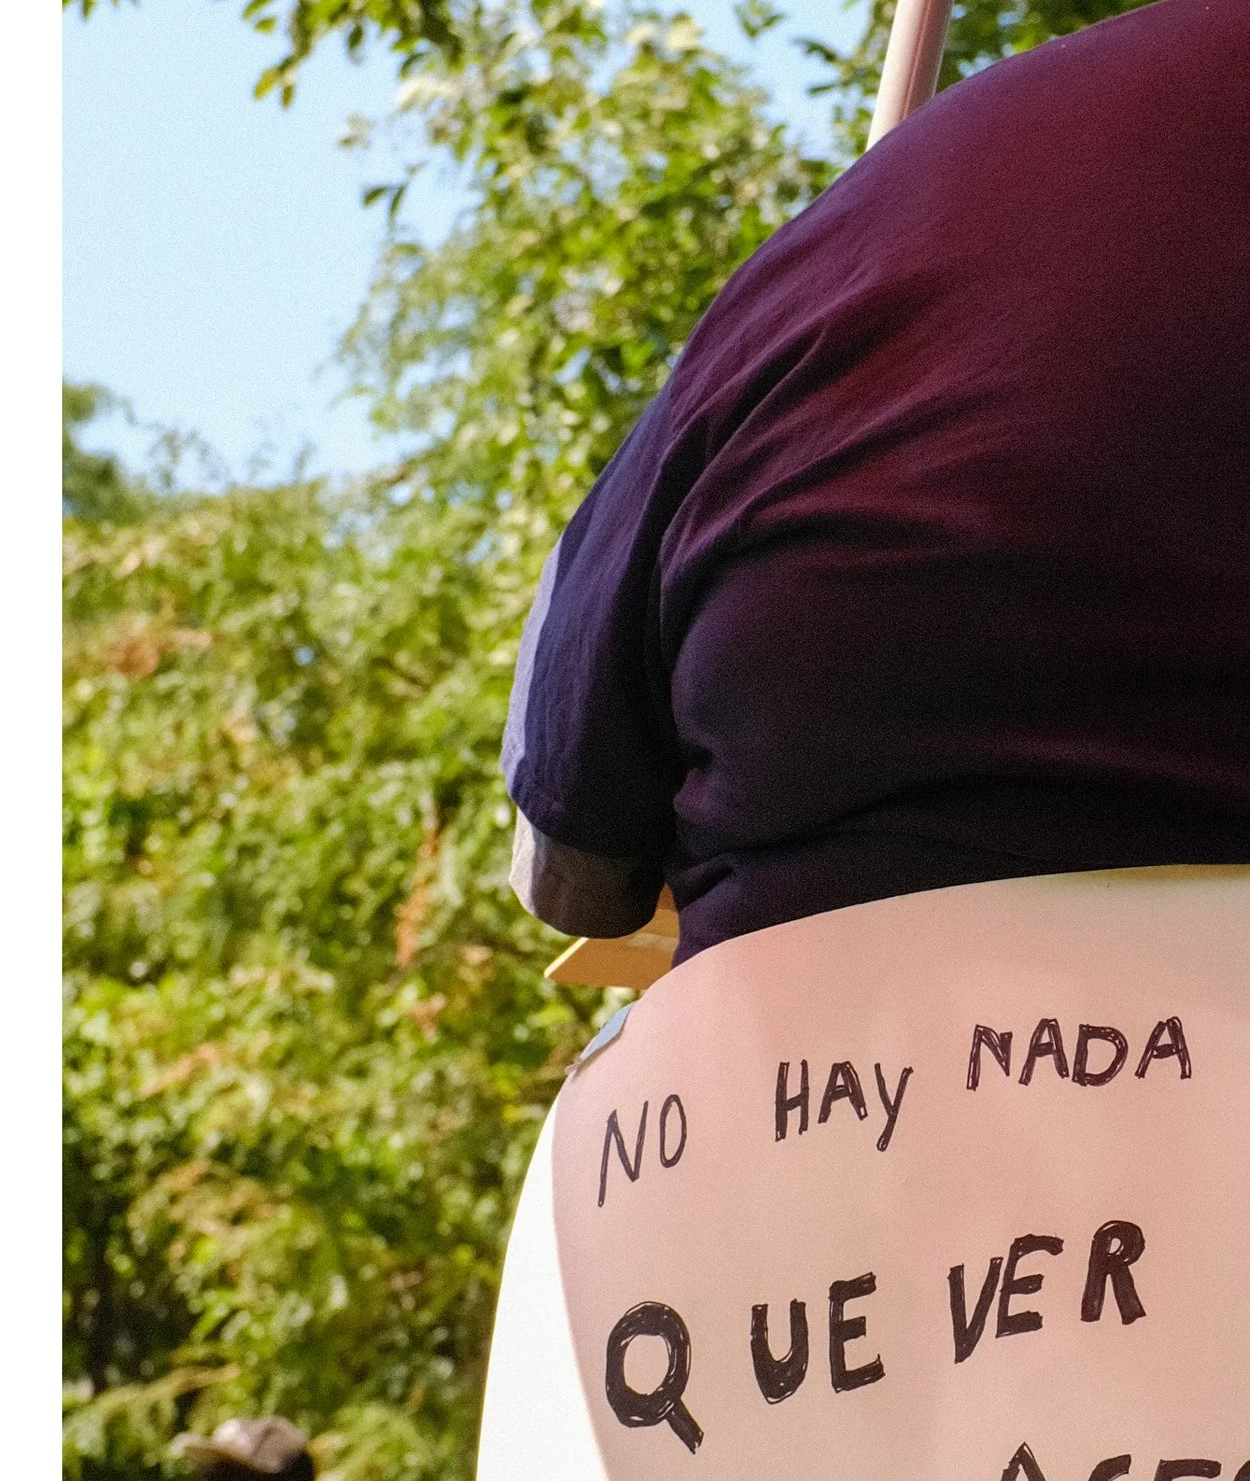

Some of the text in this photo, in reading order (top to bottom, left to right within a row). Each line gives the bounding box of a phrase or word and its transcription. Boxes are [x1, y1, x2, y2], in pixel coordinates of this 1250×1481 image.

[598, 1095, 686, 1207] NO
[775, 1060, 911, 1152] HAY
[967, 1016, 1191, 1091] NADA
[606, 1272, 884, 1454] QUE
[948, 1221, 1146, 1363] VER
